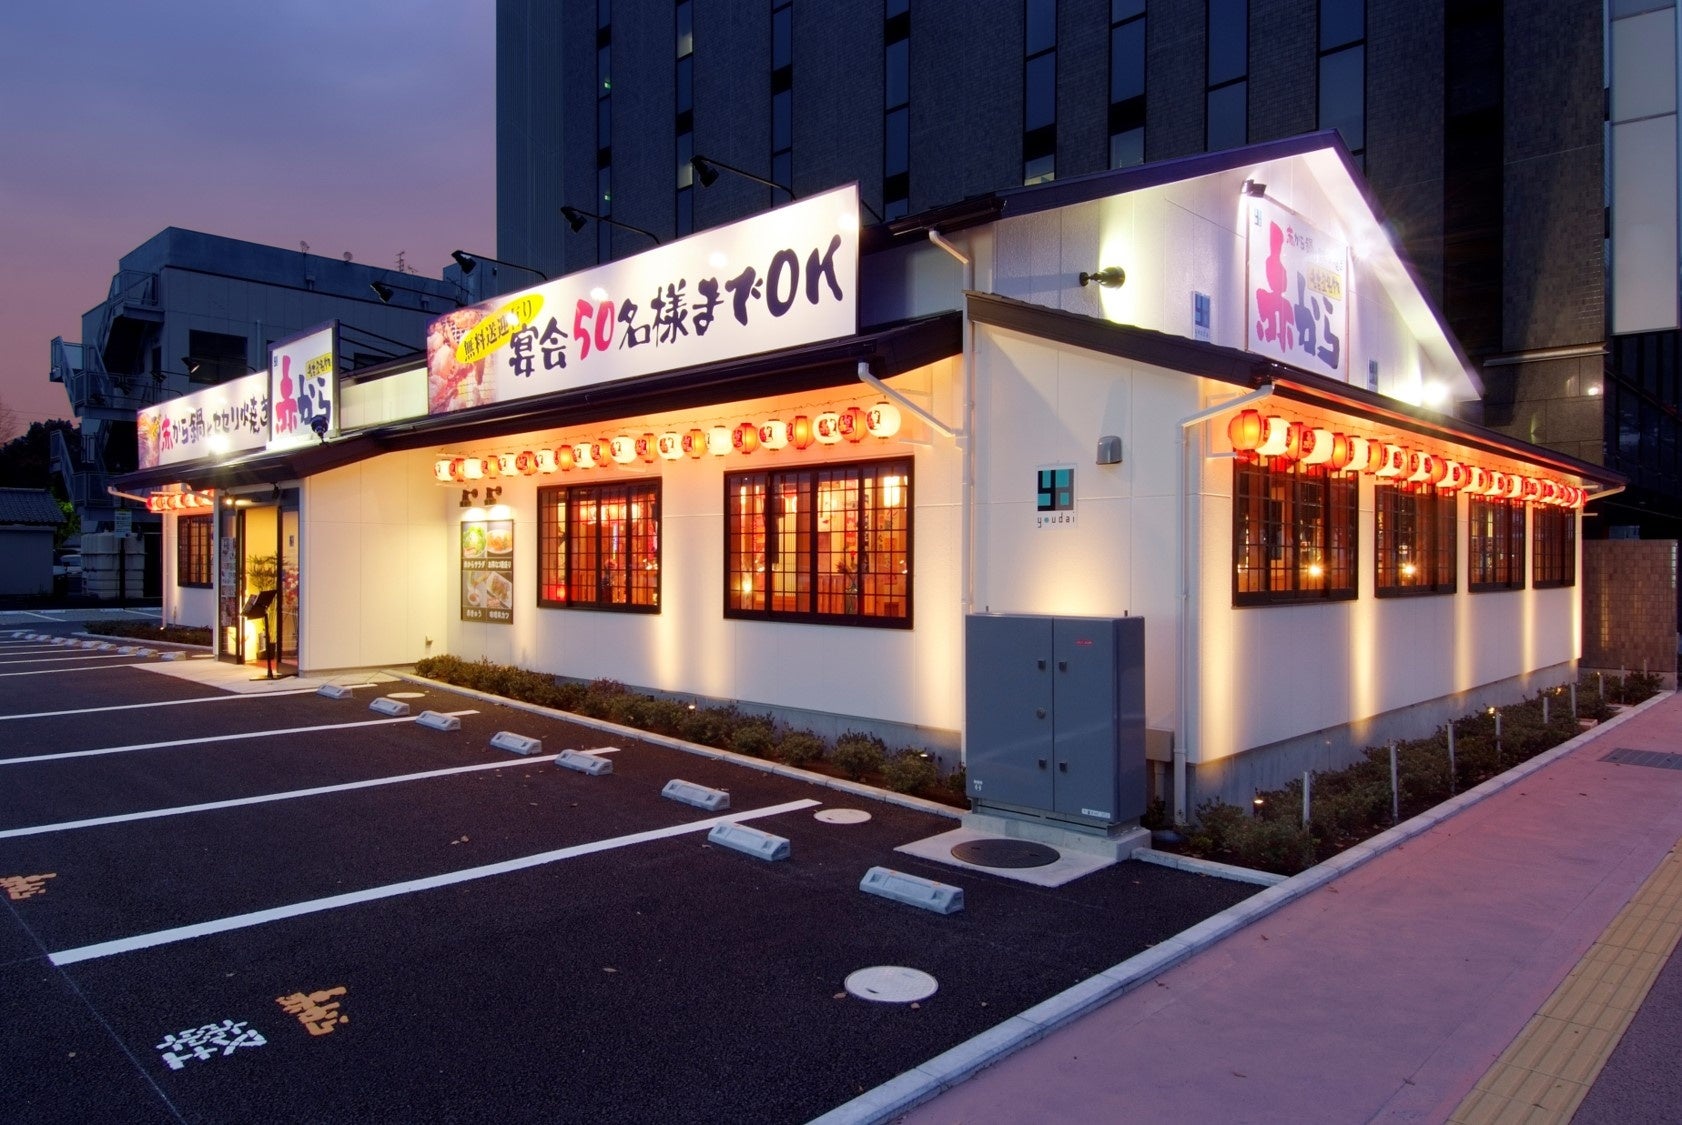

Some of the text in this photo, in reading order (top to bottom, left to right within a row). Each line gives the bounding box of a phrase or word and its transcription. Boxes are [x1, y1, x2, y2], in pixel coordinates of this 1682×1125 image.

[508, 234, 844, 378] 宴会50名様までOK
[1256, 221, 1340, 369] 赤から
[275, 355, 331, 434] 赤から
[1037, 511, 1075, 529] youdai
[156, 1019, 268, 1071] 軽
